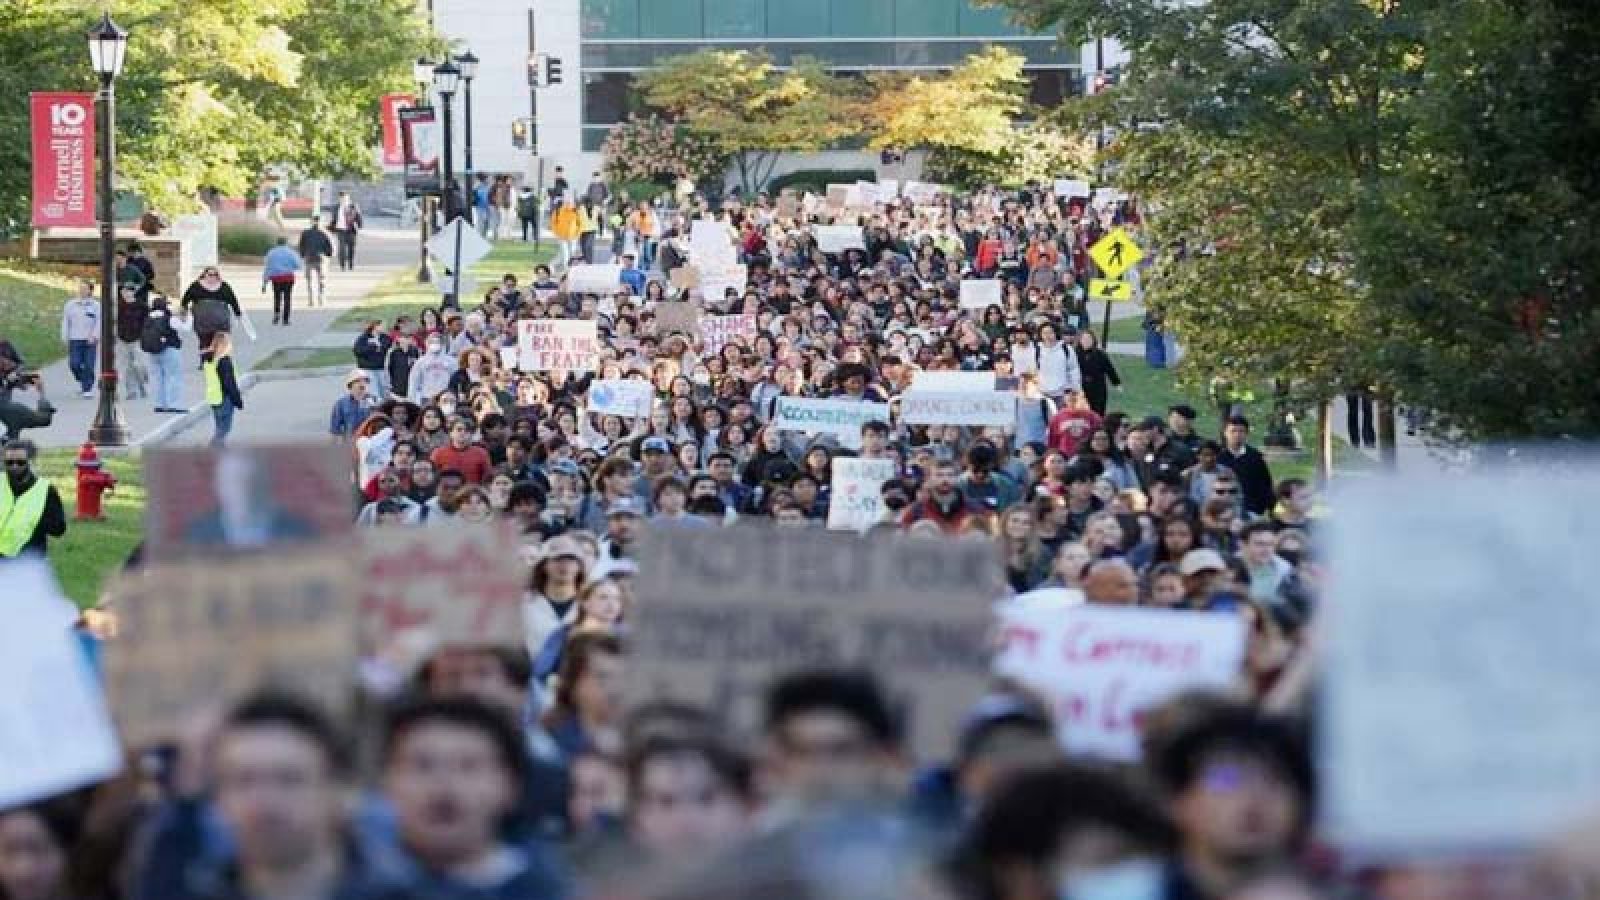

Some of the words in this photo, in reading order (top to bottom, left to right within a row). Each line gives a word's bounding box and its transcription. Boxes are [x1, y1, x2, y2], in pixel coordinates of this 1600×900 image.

[51, 103, 86, 125] 10
[50, 139, 69, 201] Cornell
[68, 139, 85, 211] Business
[703, 315, 755, 334] SHAME
[532, 335, 563, 351] BAN
[539, 351, 593, 369] FRATS
